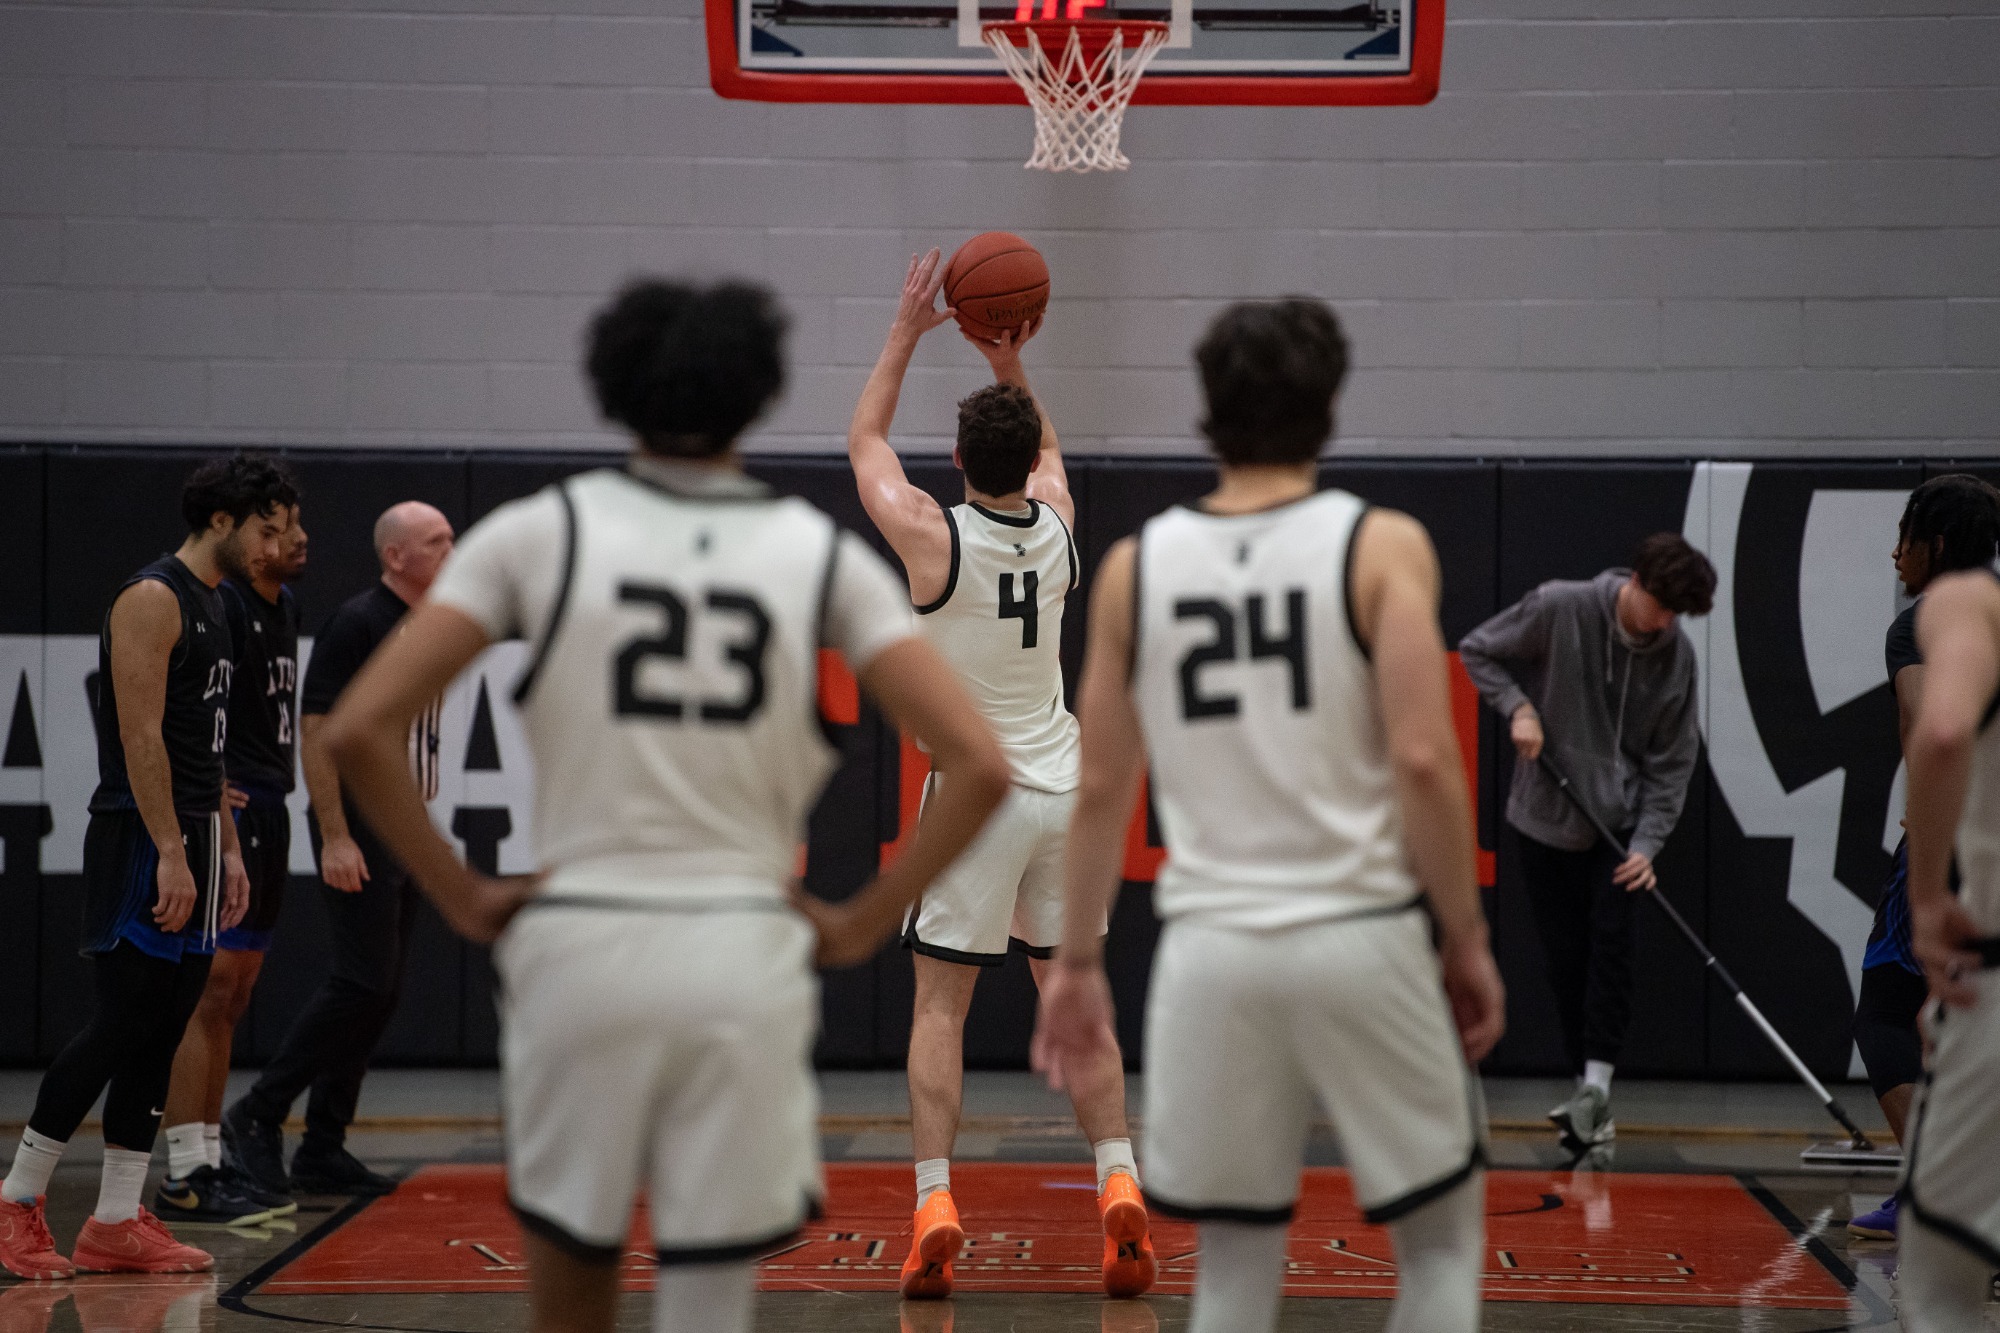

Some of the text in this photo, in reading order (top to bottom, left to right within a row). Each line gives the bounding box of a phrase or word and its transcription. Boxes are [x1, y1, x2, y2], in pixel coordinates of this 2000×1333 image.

[614, 578, 772, 724] 23
[998, 570, 1038, 649] 4
[1173, 588, 1310, 721] 24
